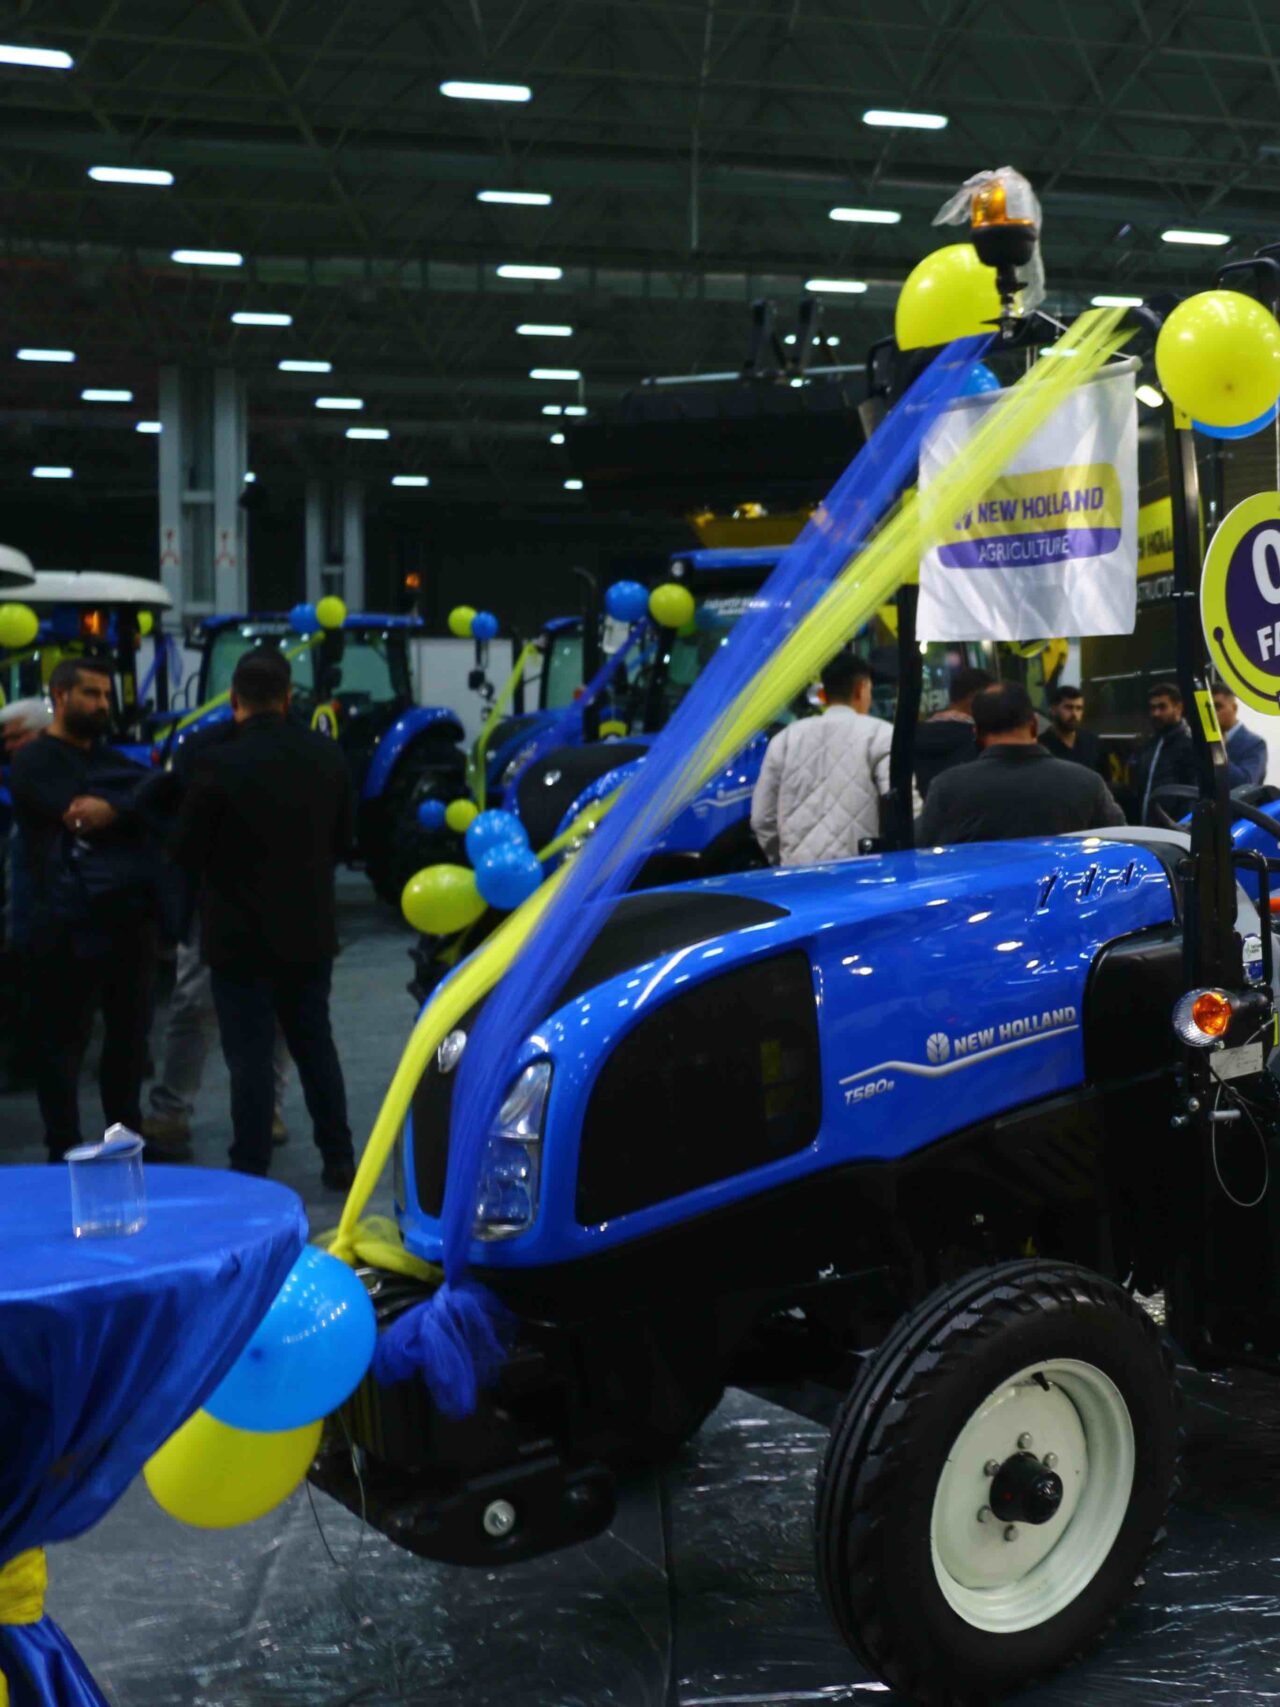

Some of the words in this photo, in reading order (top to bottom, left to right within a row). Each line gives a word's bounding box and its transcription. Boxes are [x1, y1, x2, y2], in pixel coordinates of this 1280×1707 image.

[978, 498, 1018, 523] NEW
[1022, 487, 1104, 520] HOLLAND
[979, 536, 1070, 562] AGRICULTURE
[954, 1027, 994, 1056] NEW
[999, 1006, 1076, 1035] HOLLAND
